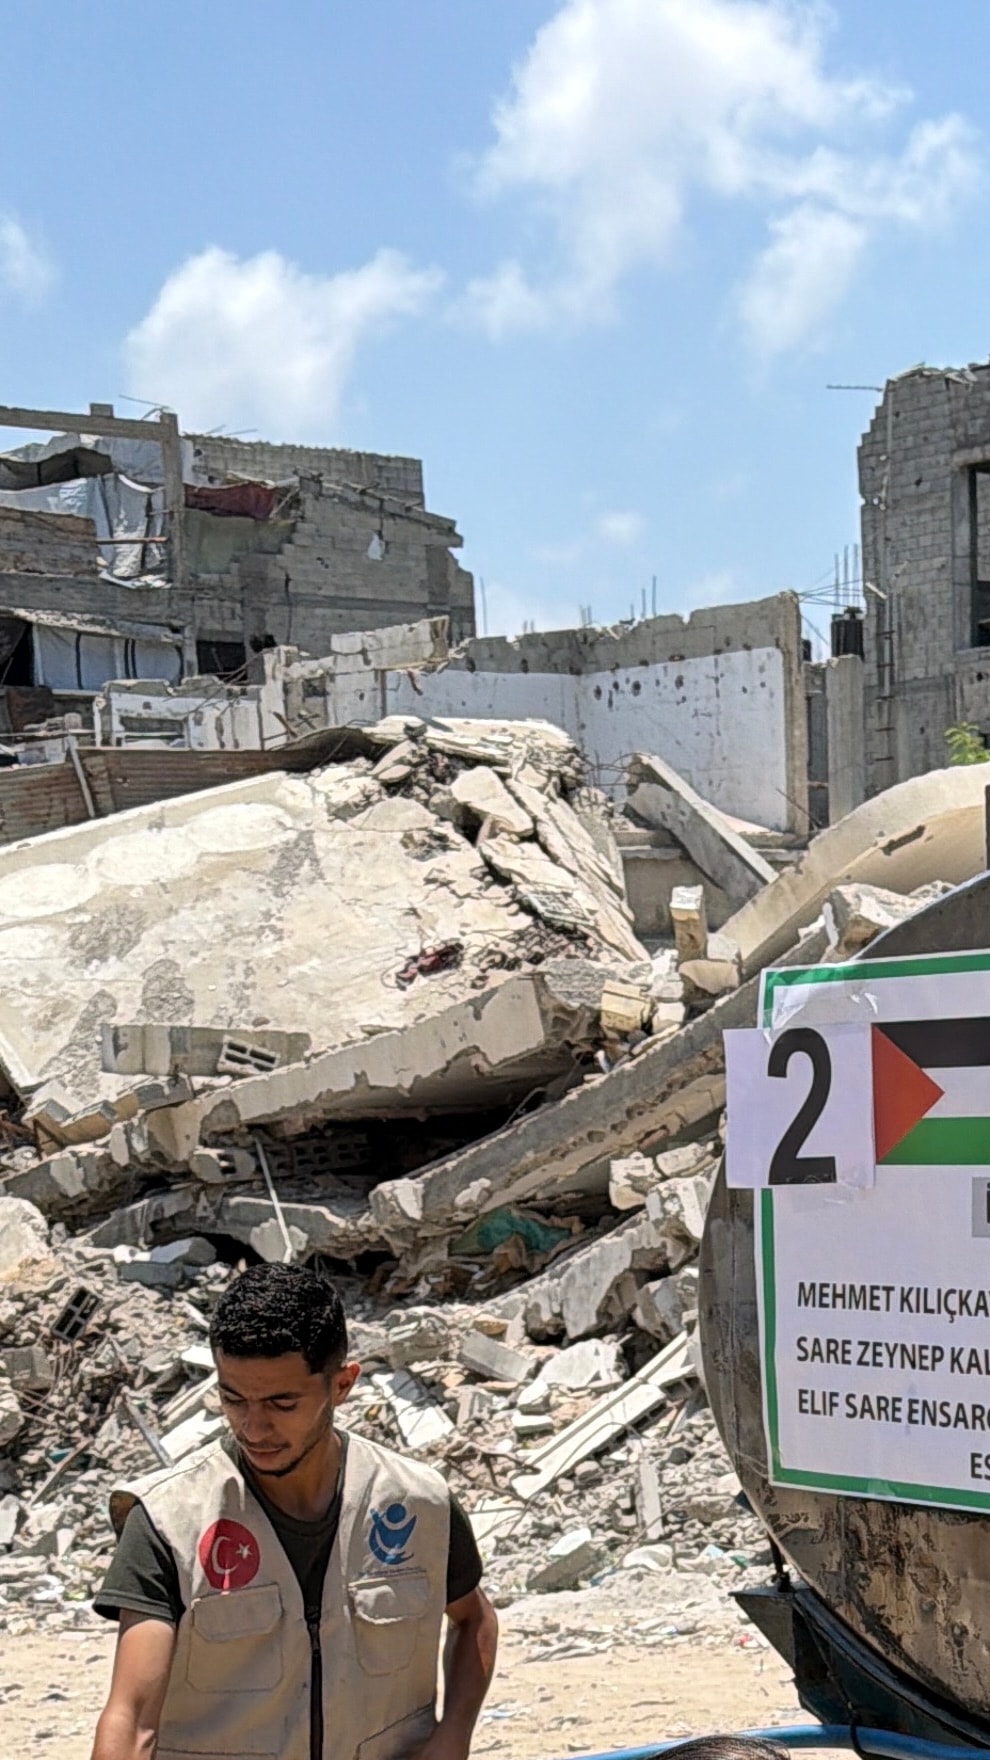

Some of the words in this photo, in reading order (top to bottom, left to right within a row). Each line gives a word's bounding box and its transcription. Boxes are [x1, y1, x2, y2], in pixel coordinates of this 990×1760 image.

[768, 1027, 837, 1185] 2
[798, 1282, 895, 1312] MEHMET
[797, 1337, 851, 1365] SARE
[857, 1341, 944, 1371] ZEYNEP
[798, 1389, 839, 1416] ELIF
[845, 1393, 902, 1423] SARE
